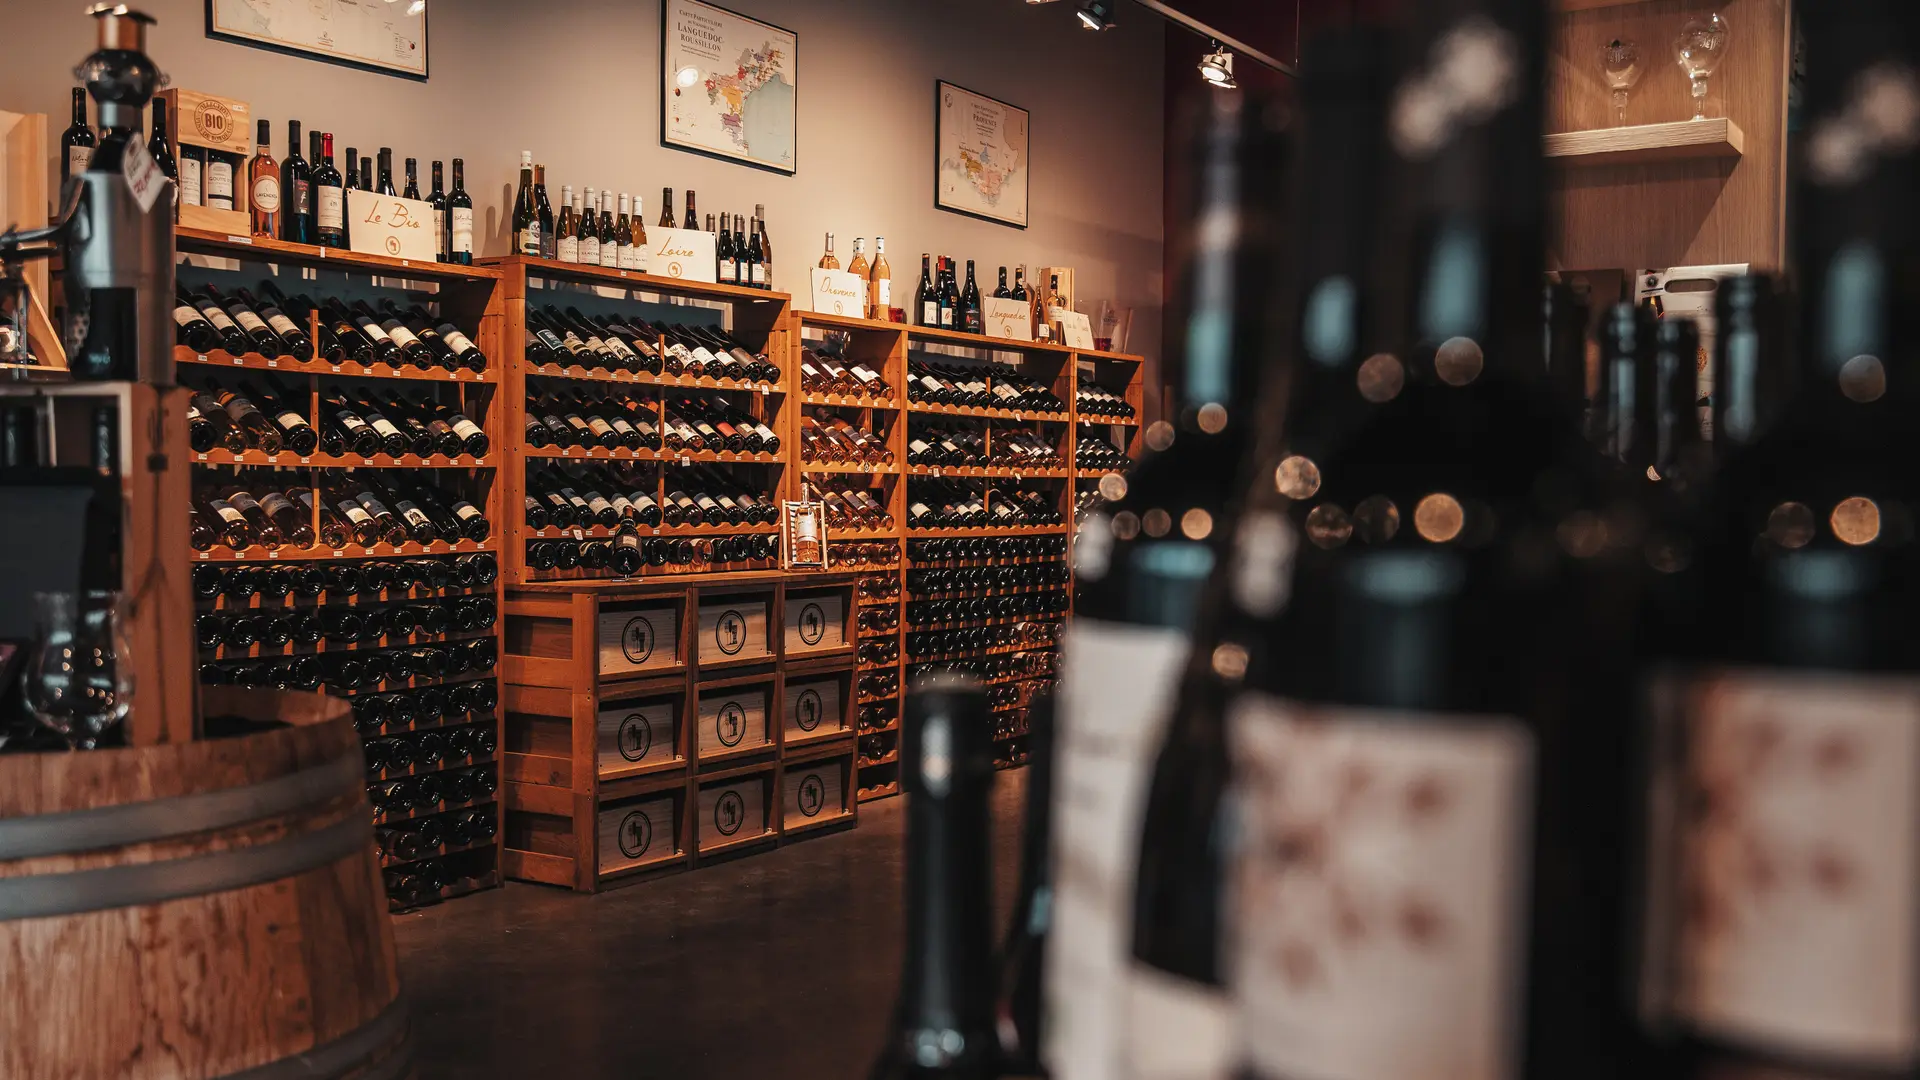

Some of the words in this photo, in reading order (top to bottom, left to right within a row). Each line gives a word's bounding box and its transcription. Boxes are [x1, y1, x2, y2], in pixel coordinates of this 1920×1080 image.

[680, 33, 722, 52] ROUSSILLON
[205, 113, 223, 130] BIO
[364, 199, 382, 224] Le
[387, 202, 420, 229] Bio
[656, 236, 695, 258] Loire
[820, 276, 856, 298] Provence
[989, 302, 1027, 325] Languedoc
